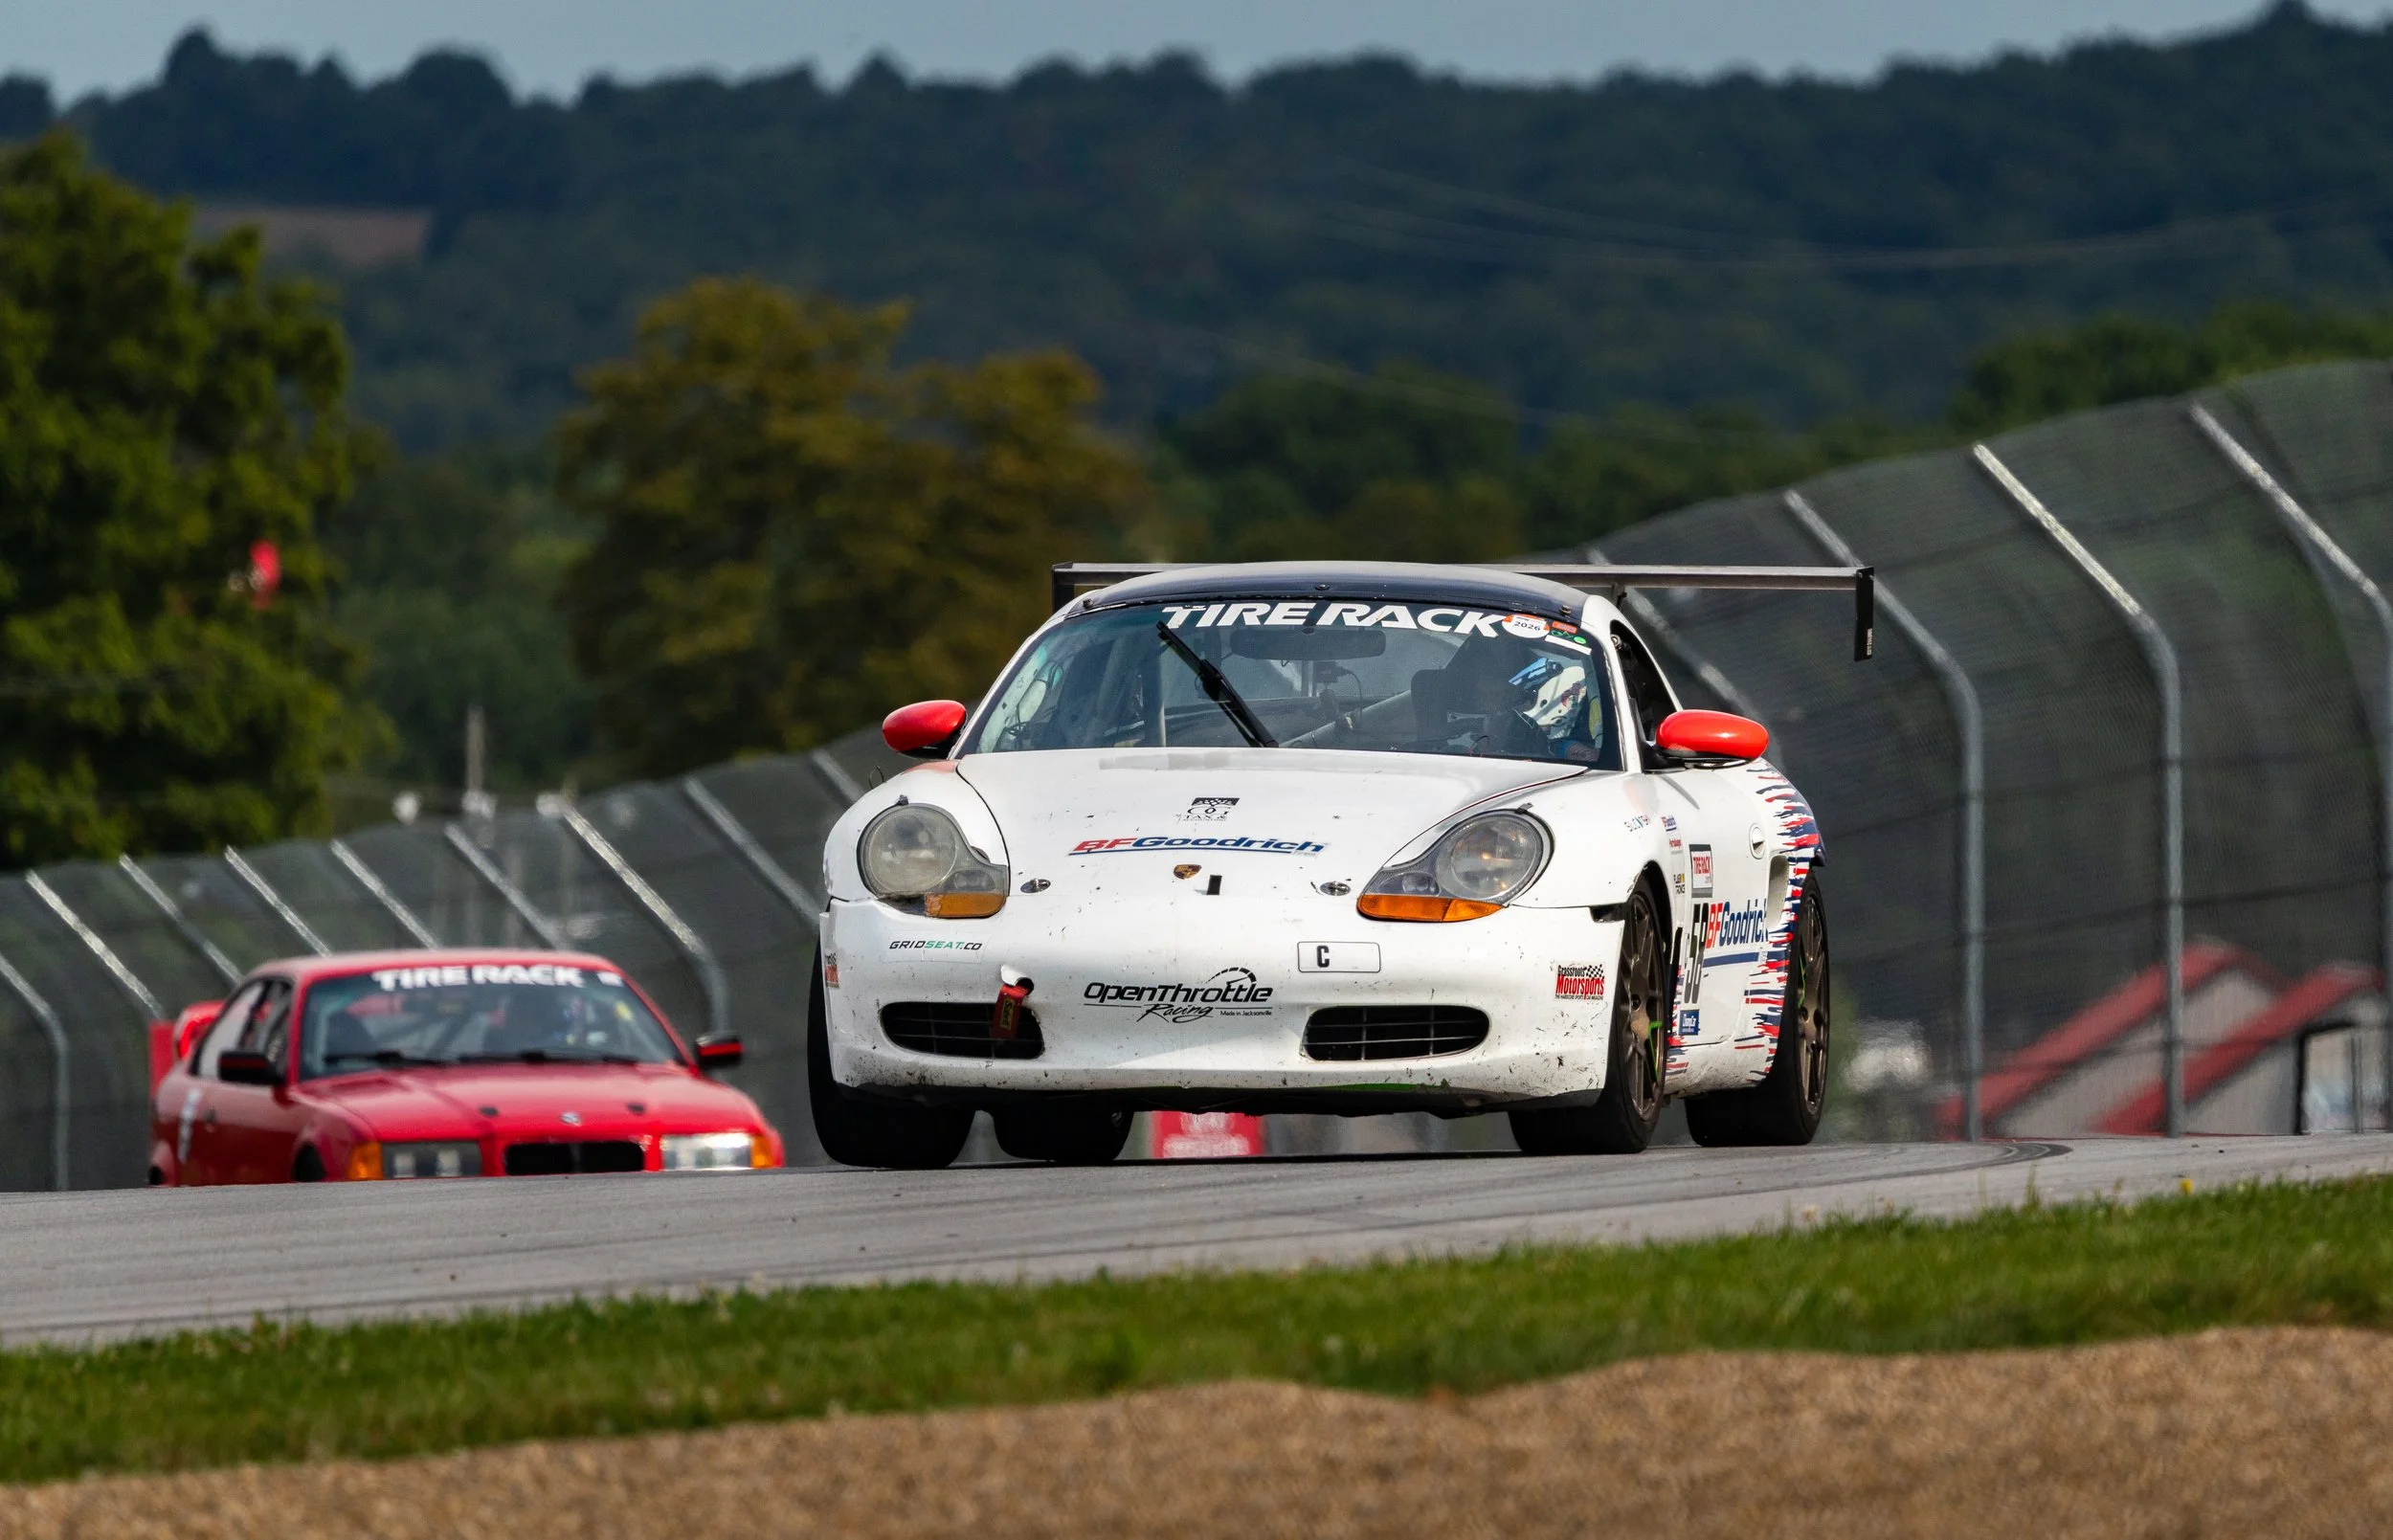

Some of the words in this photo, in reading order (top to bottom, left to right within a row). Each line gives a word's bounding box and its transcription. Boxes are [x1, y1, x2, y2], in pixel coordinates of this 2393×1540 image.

[1162, 602, 1317, 630] TIRE
[1315, 602, 1505, 638] RACK
[1513, 620, 1541, 632] 2026
[1073, 836, 1326, 853] BFGoodrich
[1705, 899, 1769, 949] BFGoodrich
[889, 941, 982, 950] GRIDSEAT.CO
[1317, 946, 1330, 968] C
[371, 966, 469, 992] TIRE
[471, 964, 585, 988] RACK
[1556, 974, 1604, 999] Motorsports
[1084, 982, 1273, 1003] OpenThrottle
[1136, 1004, 1214, 1023] Racing
